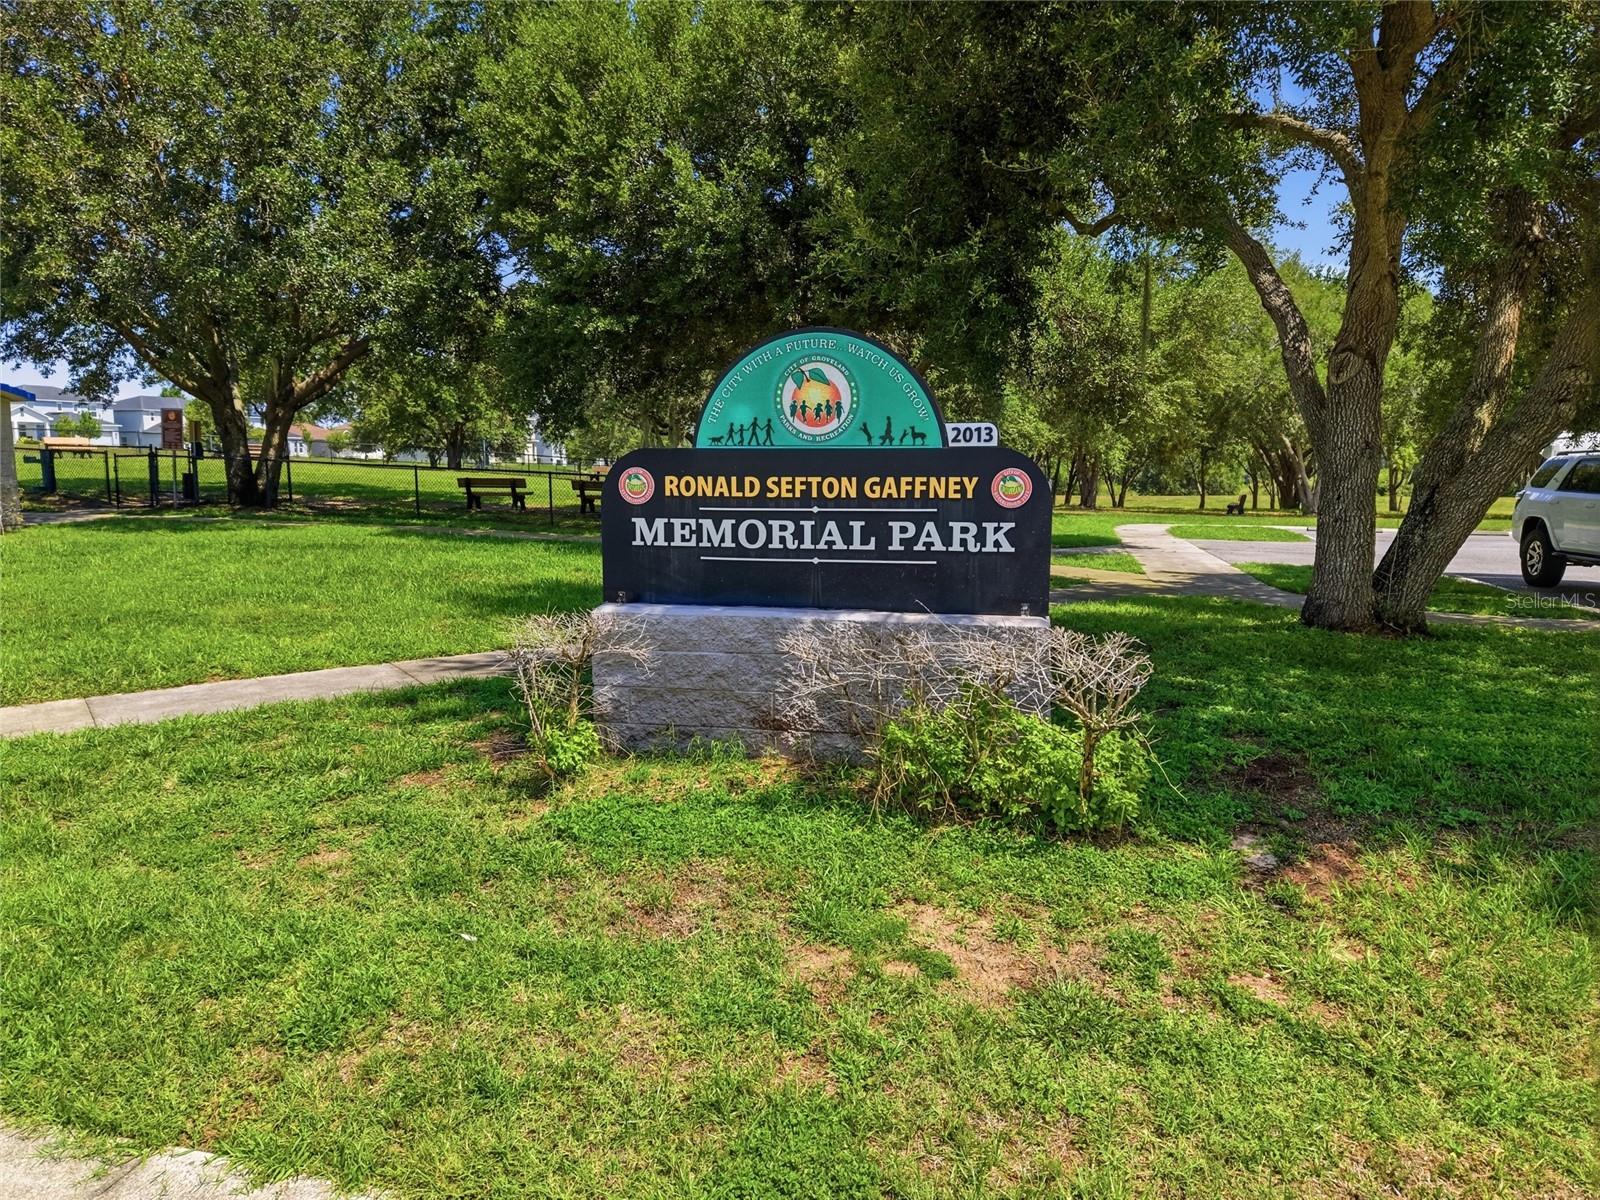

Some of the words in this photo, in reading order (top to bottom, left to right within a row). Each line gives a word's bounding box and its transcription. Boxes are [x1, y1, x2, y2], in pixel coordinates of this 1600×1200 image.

[784, 363, 798, 376] CITY
[799, 357, 809, 365] OF
[811, 355, 850, 376] GROVELAND
[707, 399, 725, 424] THE
[722, 373, 743, 399] CITY
[742, 350, 773, 375] WITH
[774, 347, 784, 357] A
[848, 342, 888, 371] WATCH
[888, 368, 903, 384] US
[902, 383, 929, 423] GROW!
[779, 414, 796, 435] PARKS
[798, 433, 813, 441] AND
[816, 414, 854, 442] RECREATION
[950, 426, 994, 443] 2013
[664, 475, 761, 497] RONALD
[766, 475, 858, 498] SEFTON
[863, 476, 979, 499] GAFFNEY
[631, 517, 876, 551] MEMORIAL
[888, 521, 1017, 554] PARK
